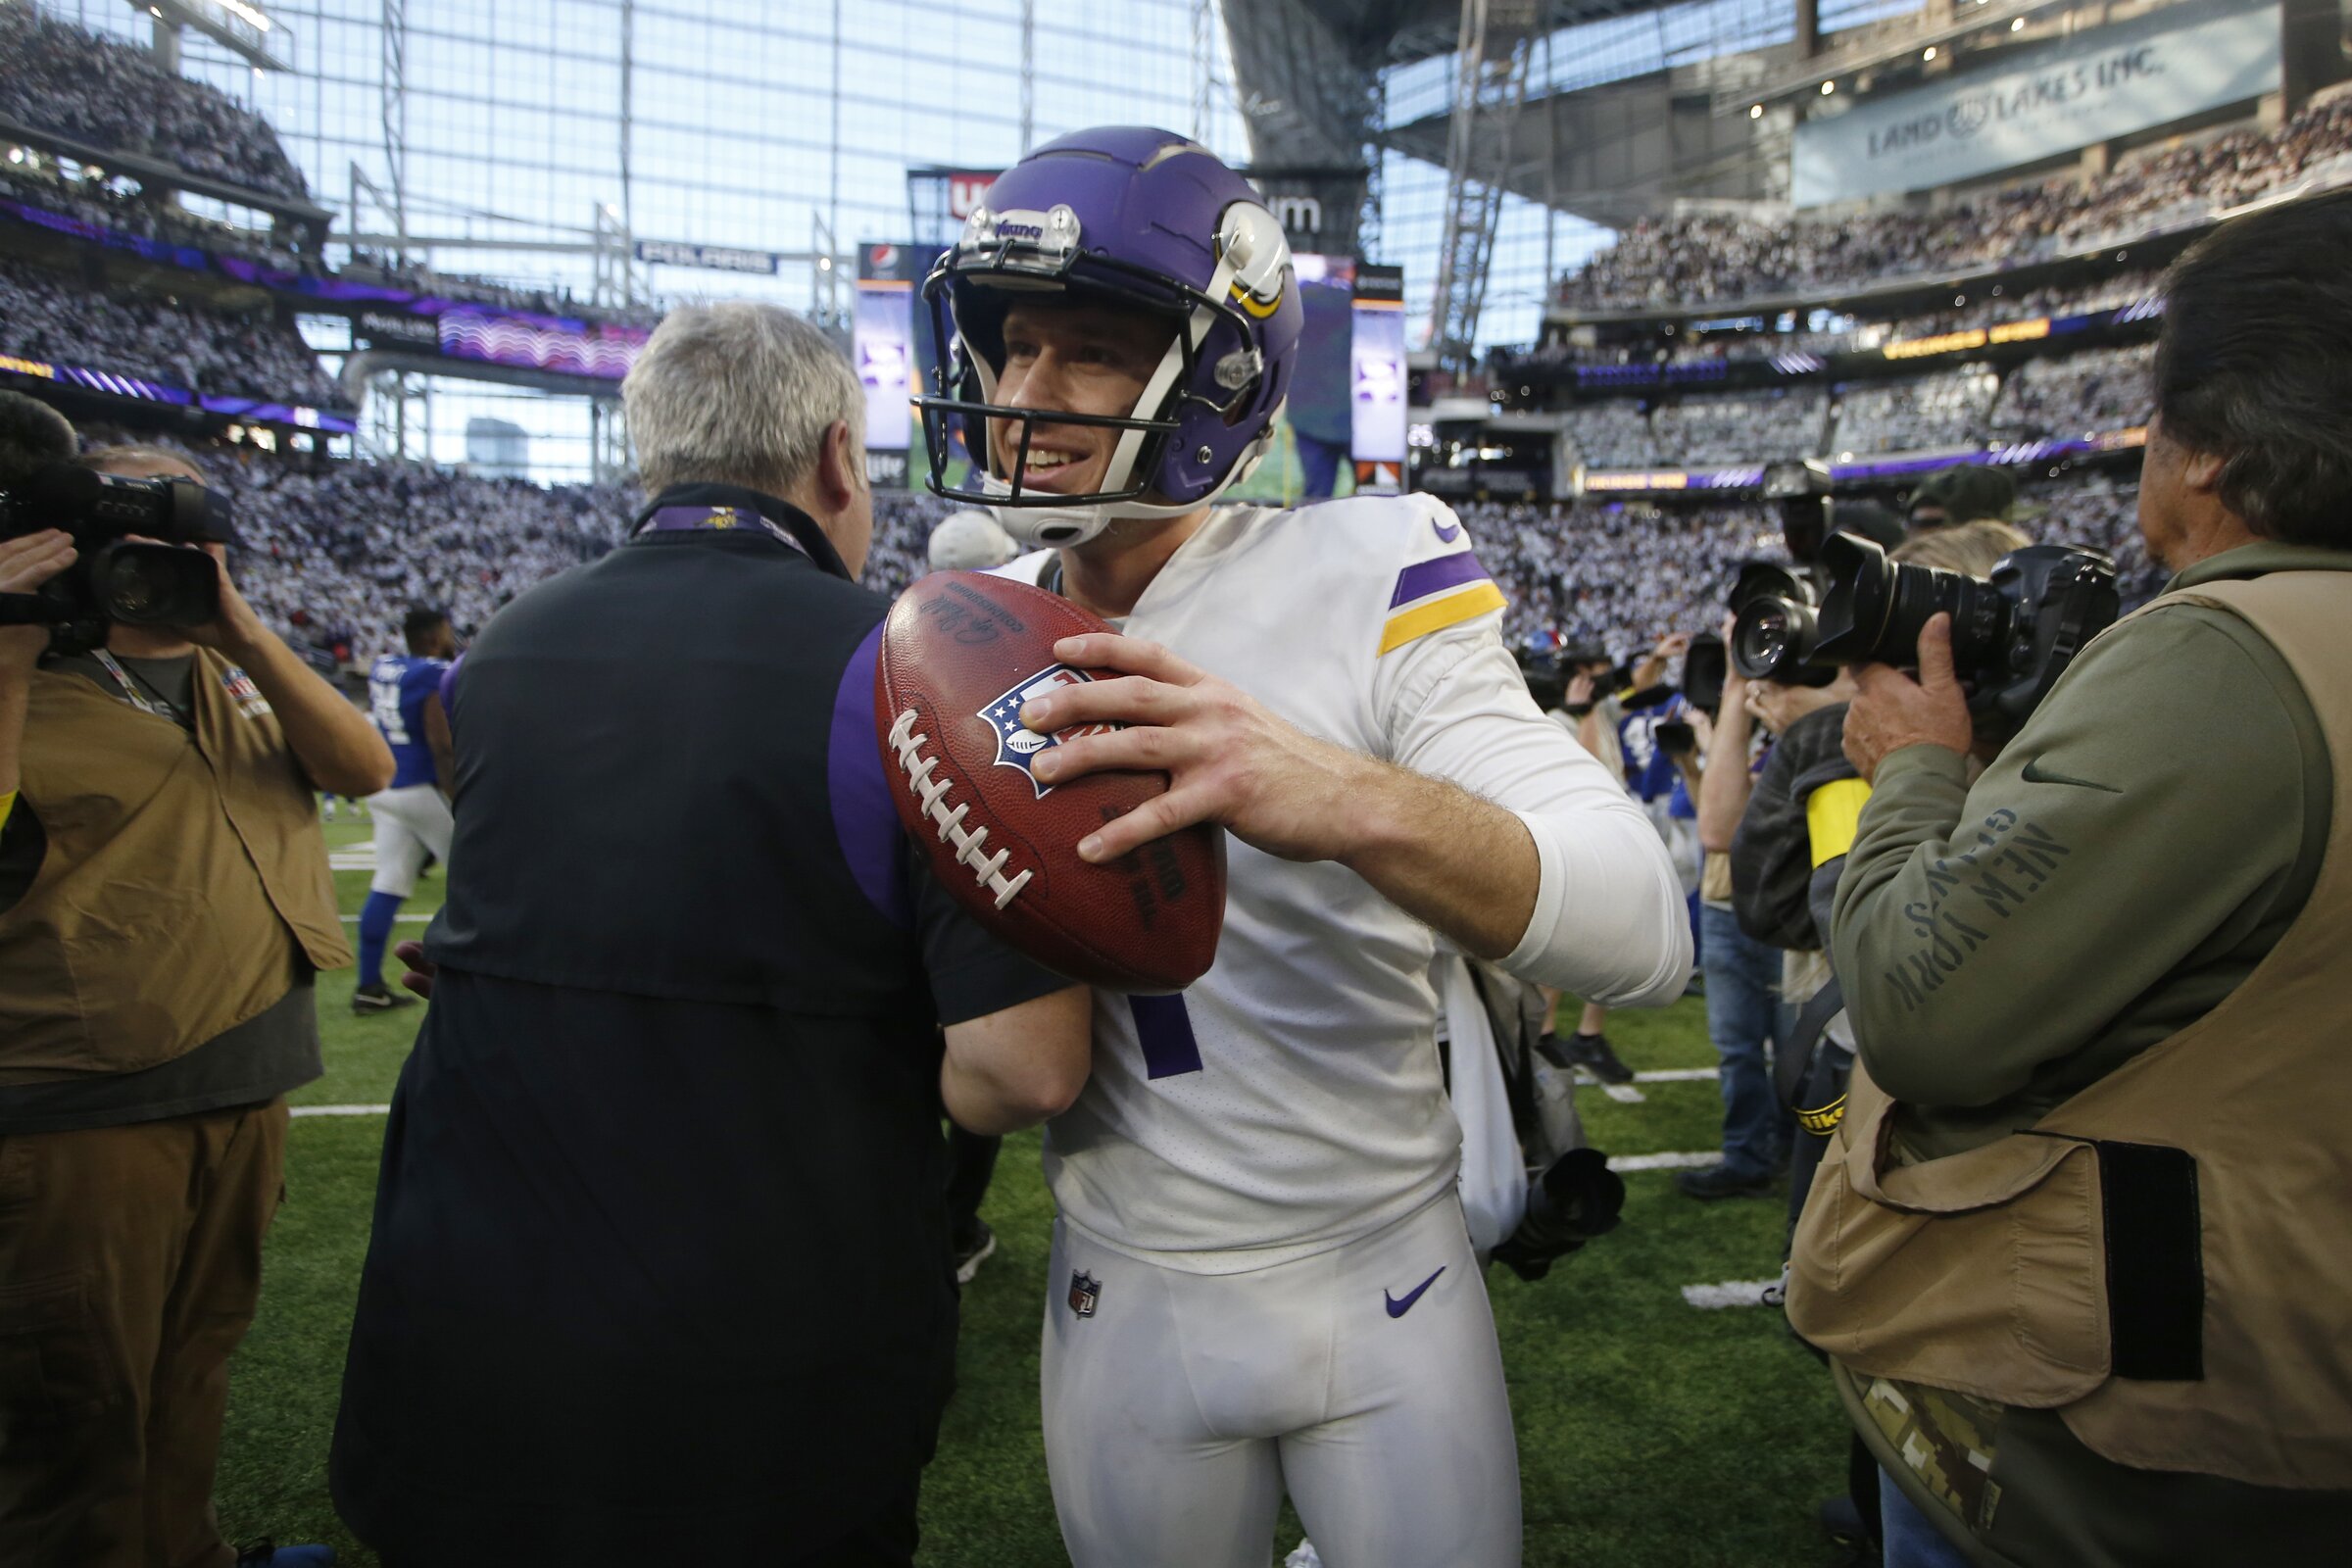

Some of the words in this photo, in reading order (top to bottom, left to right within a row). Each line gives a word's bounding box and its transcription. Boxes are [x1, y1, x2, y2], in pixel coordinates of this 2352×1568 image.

[1866, 112, 1942, 160] LAND
[1995, 69, 2087, 122] LAKES
[1971, 821, 2071, 919] NEW
[1884, 910, 1989, 1012] YORK
